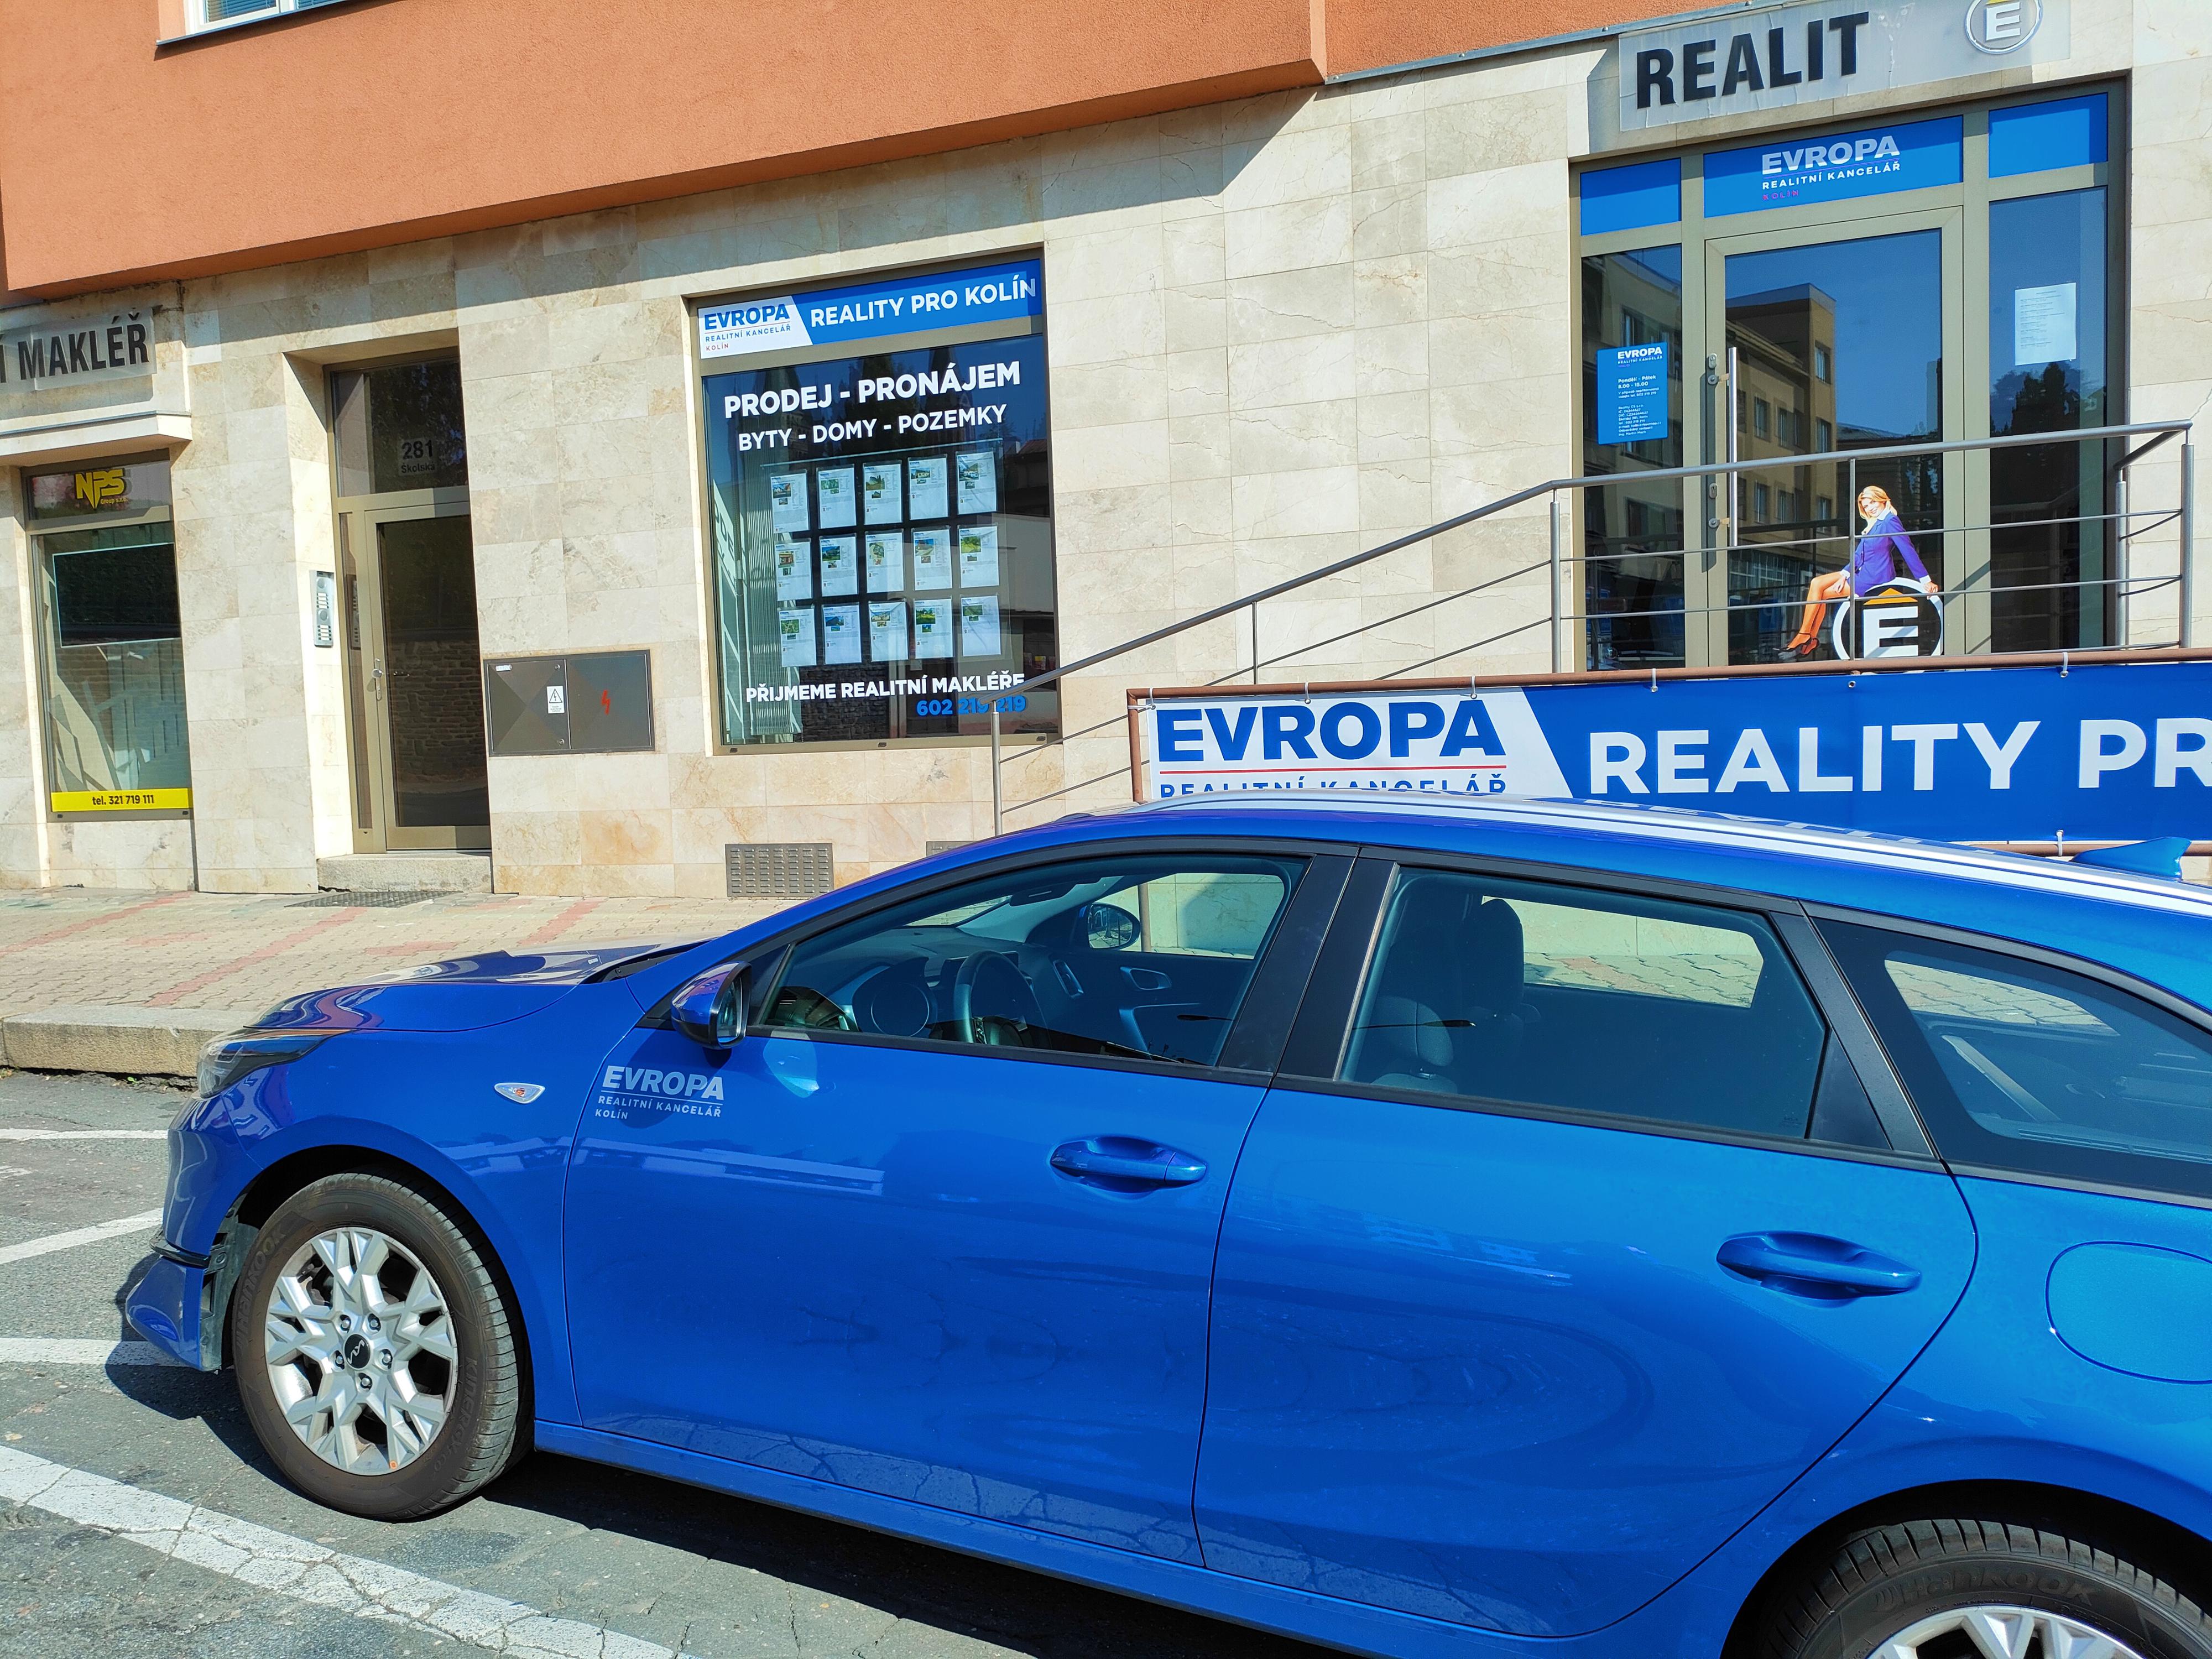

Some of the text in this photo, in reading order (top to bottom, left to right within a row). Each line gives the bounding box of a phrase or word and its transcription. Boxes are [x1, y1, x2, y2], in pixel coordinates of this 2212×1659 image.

[1637, 12, 1869, 109] REALIT
[1762, 135, 1900, 175] EVROPA
[1762, 161, 1900, 190] REALITNÍ KANCELÁŘ
[1762, 189, 1799, 201] KOLÍN
[810, 275, 1036, 327] REALITY PRO KOLÍN
[704, 304, 790, 330] EVROPA
[18, 312, 150, 380] MAKLÉŘ
[706, 324, 791, 342] REALITNÍ KANCELÁŘ
[1618, 347, 1662, 359] EVROPA
[724, 384, 832, 418] PRODEJ
[858, 362, 1021, 403] PRONÁJEM
[739, 429, 792, 451] BYTY
[813, 419, 878, 443] DOMY
[899, 404, 1007, 434] POZEMKY
[402, 440, 433, 460] 281
[401, 461, 435, 473] Školská
[75, 469, 125, 509] NPS
[1863, 606, 1918, 658] E
[747, 684, 836, 702] PŘIJMEME
[842, 675, 927, 698] REALITNÍ
[916, 699, 953, 716] 602
[996, 695, 1026, 712] 219
[1156, 700, 1506, 762] EVROPA
[1590, 718, 2212, 794] REALITY PR
[92, 795, 154, 805] tel. 321 719 111
[602, 1065, 724, 1100] EVROPA
[595, 1108, 628, 1120] KOLÍN
[598, 1095, 721, 1118] REALITNÍ KANCELÁŘ
